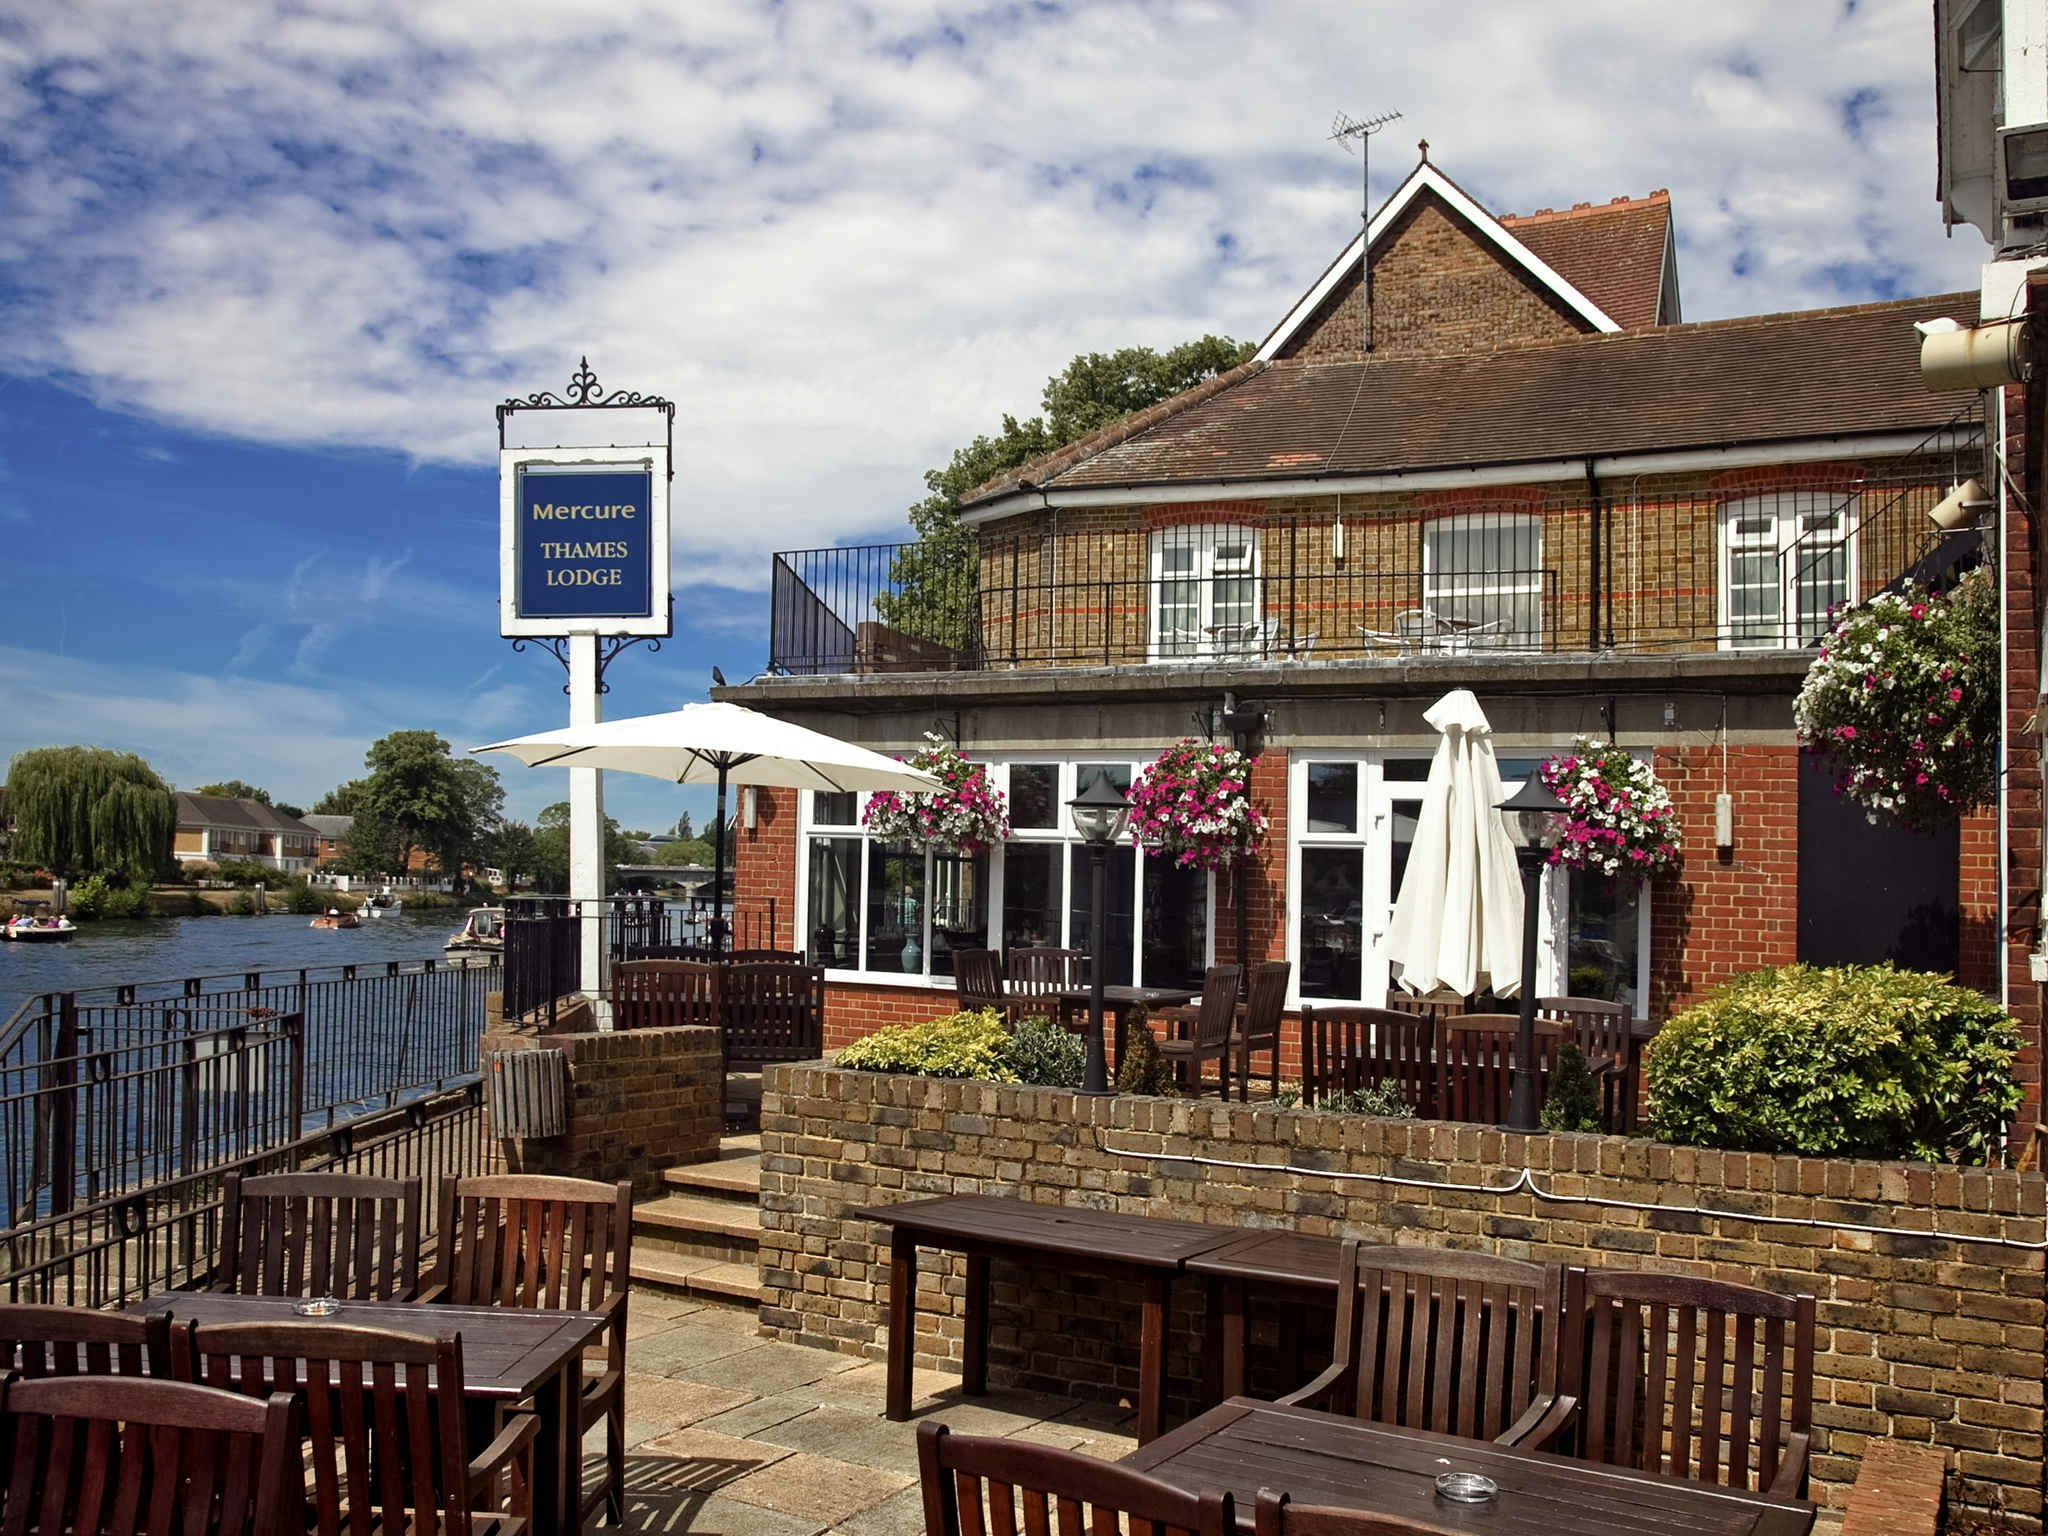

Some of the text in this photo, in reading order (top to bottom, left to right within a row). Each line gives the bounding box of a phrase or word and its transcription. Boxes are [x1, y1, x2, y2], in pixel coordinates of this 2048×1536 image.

[533, 503, 636, 520] Mercure
[540, 541, 628, 559] THAMES
[546, 568, 622, 586] LODGE
